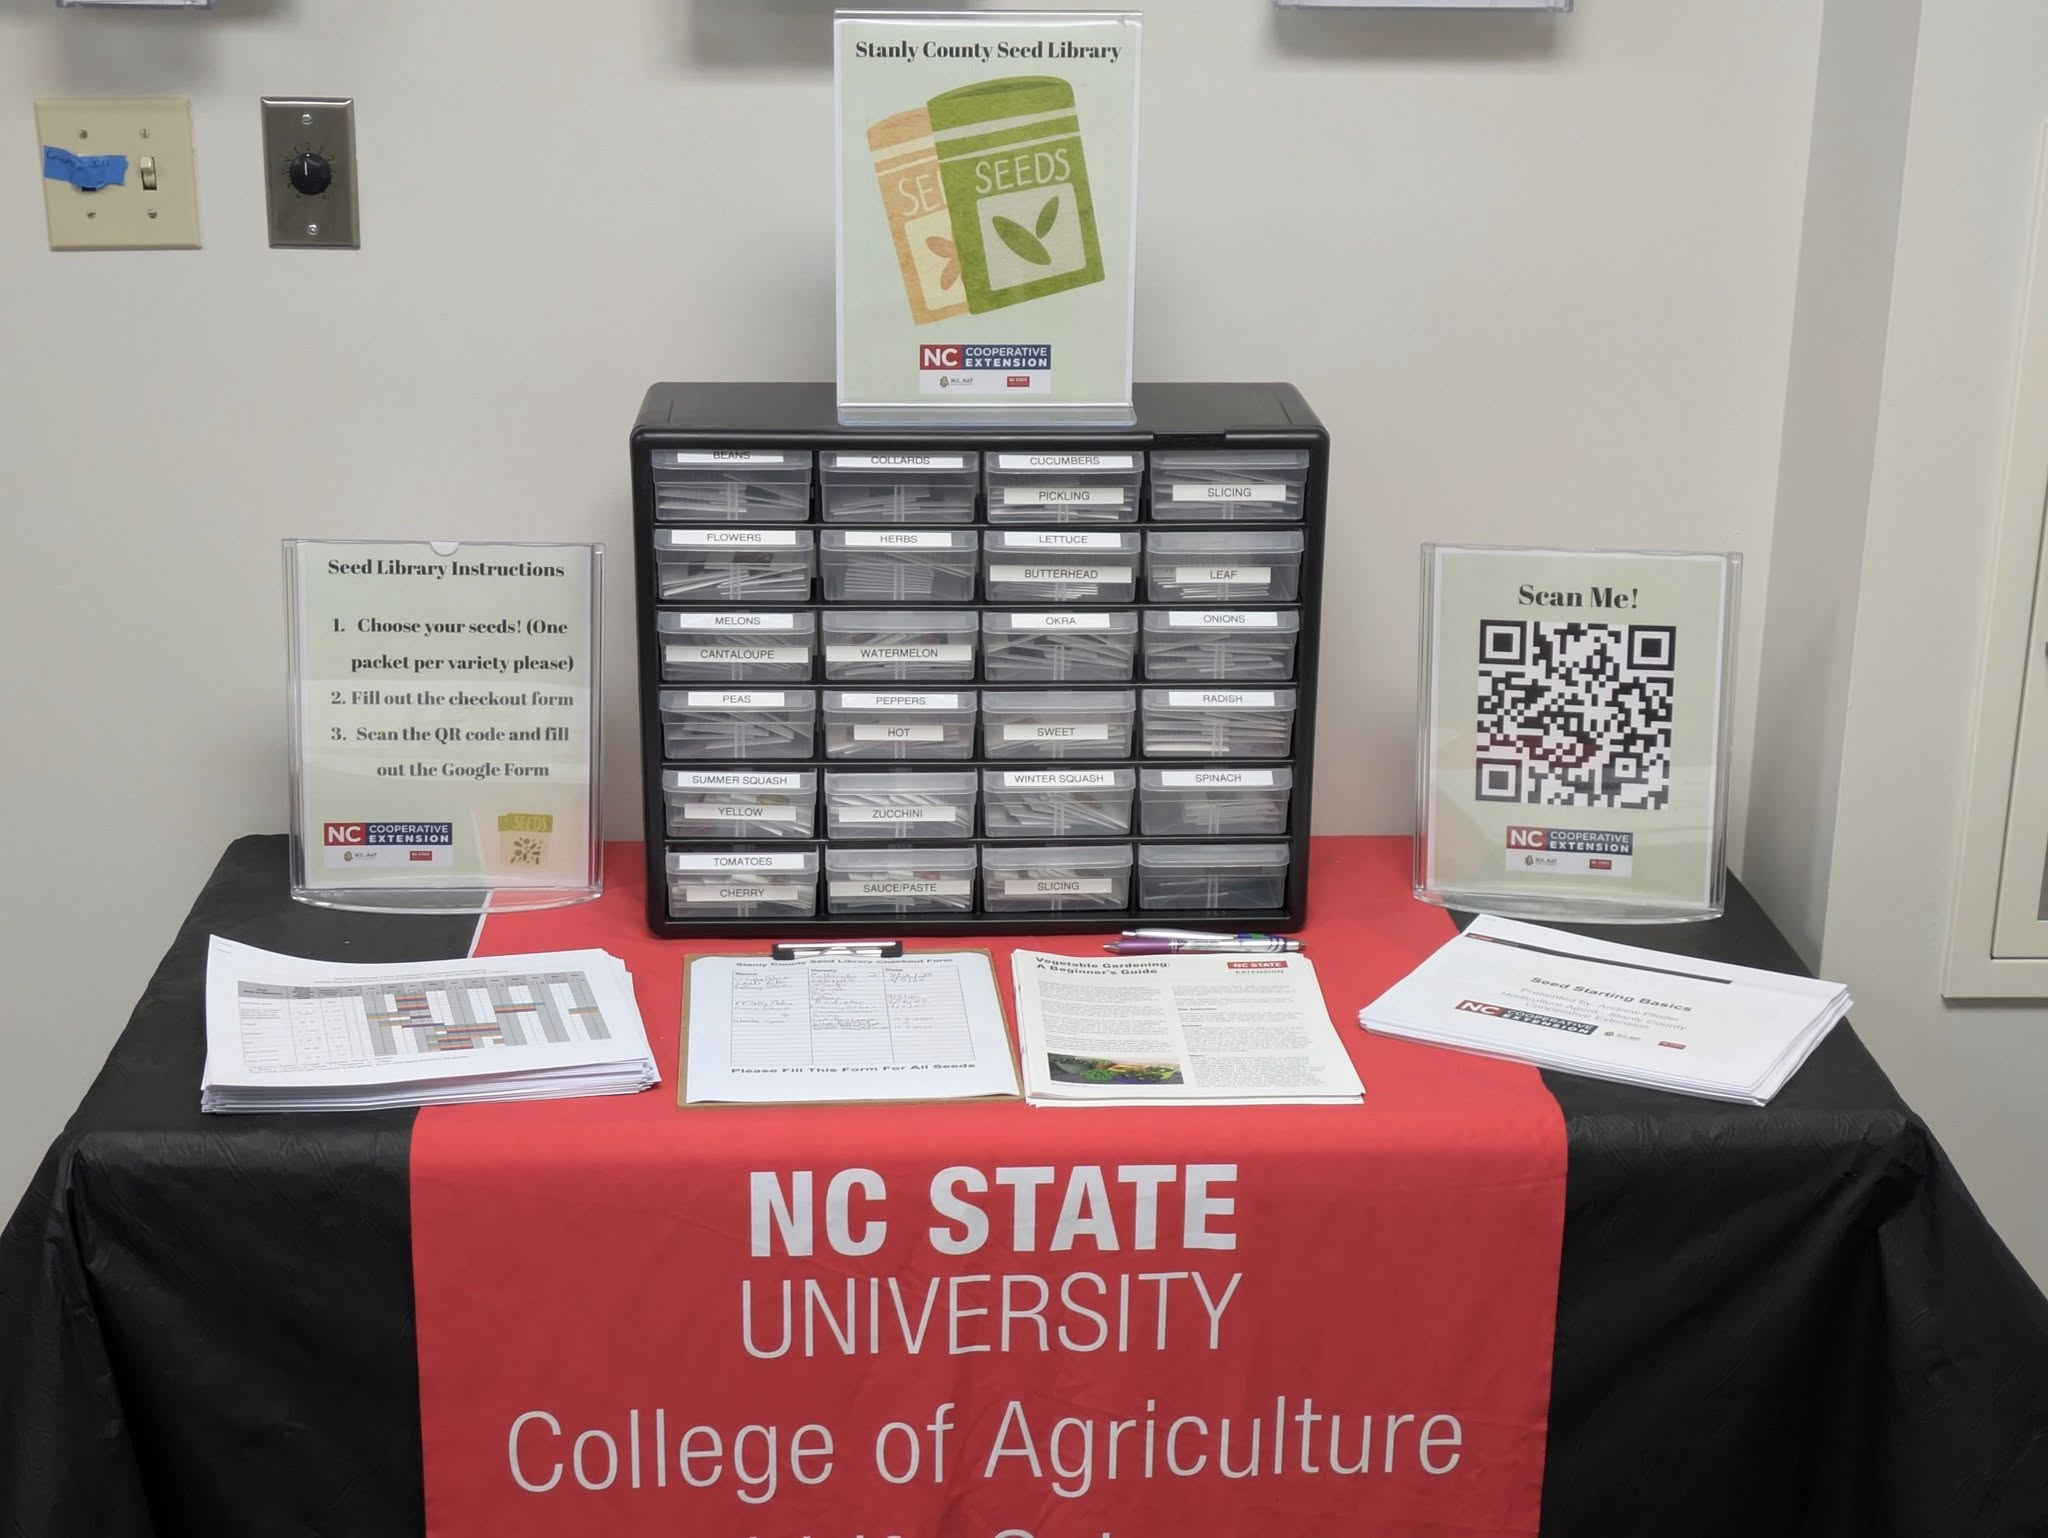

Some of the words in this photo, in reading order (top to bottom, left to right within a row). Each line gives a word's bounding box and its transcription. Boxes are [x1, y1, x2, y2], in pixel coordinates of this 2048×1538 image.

[855, 41, 918, 62] Stanly
[923, 42, 993, 63] County
[997, 41, 1043, 59] Seed
[1048, 41, 1122, 63] Library
[975, 148, 1071, 194] SEEDS
[965, 347, 1048, 357] COOPERATIVE
[924, 348, 958, 367] NC
[965, 358, 1048, 367] EXTENSION
[712, 451, 750, 460] BEANS
[870, 456, 930, 465] COLLARDS
[1029, 456, 1100, 466] CUCUMBERS
[1038, 490, 1090, 501] PICKLING
[1206, 488, 1252, 498] SLICING
[706, 533, 762, 542] FLOWERS
[880, 534, 918, 544] HERBS
[1038, 535, 1088, 544] LETTUCE
[328, 559, 372, 575] Seed
[376, 560, 448, 580] Library
[452, 561, 565, 578] Instructions
[1024, 568, 1098, 580] BUTTERHEAD
[1210, 570, 1237, 580] LEAF
[1518, 584, 1583, 608] Scan
[1589, 586, 1639, 609] Me!
[714, 616, 761, 626] MELONS
[1045, 616, 1077, 625] OKRA
[1202, 614, 1246, 624] ONIONS
[332, 618, 346, 632] 1.
[357, 618, 421, 632] Choose
[424, 622, 466, 637] your
[468, 620, 522, 634] seeds!
[526, 619, 568, 636] (One
[700, 650, 775, 660] CANTALOUPE
[860, 648, 938, 658] WATERMELON
[351, 655, 410, 672] packet
[414, 657, 444, 673] per
[448, 656, 510, 674] variety
[513, 655, 574, 674] please)
[330, 690, 346, 705] 2.
[351, 690, 380, 705] Fill
[384, 692, 412, 706] out
[416, 690, 446, 706] the
[449, 692, 529, 706] checkout
[531, 692, 574, 706] form
[722, 694, 752, 704] PEAS
[876, 696, 926, 705] PEPPERS
[1202, 694, 1244, 703] RADISH
[331, 727, 346, 741] 3.
[356, 727, 399, 741] Scan
[402, 727, 432, 741] the
[434, 727, 462, 742] QR
[465, 727, 506, 741] code
[508, 727, 541, 741] and
[545, 727, 570, 741] fill
[886, 728, 911, 738] HOT
[1036, 727, 1076, 737] SWEET
[376, 764, 404, 777] out
[409, 763, 438, 777] the
[442, 763, 500, 780] Google
[504, 763, 550, 777] Form
[692, 775, 740, 785] SUMMER
[742, 776, 788, 786] SQUASH
[1014, 774, 1056, 784] WINTER
[1058, 774, 1104, 784] SQUASH
[1194, 774, 1242, 784] SPINACH
[718, 807, 764, 817] YELLOW
[872, 809, 923, 819] ZUCCHINI
[368, 824, 449, 834] COOPERATIVE
[328, 826, 362, 843] NC
[368, 834, 449, 843] EXTENSION
[1510, 829, 1543, 848] NC
[1550, 831, 1630, 844] COOPERATIVE
[1550, 840, 1629, 853] EXTENSION
[712, 857, 773, 866] TOMATOES
[862, 883, 937, 894] SAUCE/PASTE
[1036, 881, 1080, 892] SLICING
[719, 888, 766, 898] CHERRY
[1036, 956, 1098, 968] Vegetable
[1050, 965, 1118, 975] Beginner's
[1530, 976, 1570, 990] Seed
[1572, 986, 1635, 1002] Starting
[1638, 997, 1692, 1012] Basics
[1460, 1001, 1500, 1014] NC
[1502, 1013, 1590, 1034] EXTENSION
[1507, 1009, 1594, 1030] COOPERATIVE
[750, 1167, 887, 1257] NC
[929, 1163, 1238, 1256] STATE
[741, 1271, 1243, 1359] UNIVERSITY
[508, 1408, 834, 1504] College
[875, 1402, 955, 1484] of
[983, 1395, 1462, 1498] Agriculture
